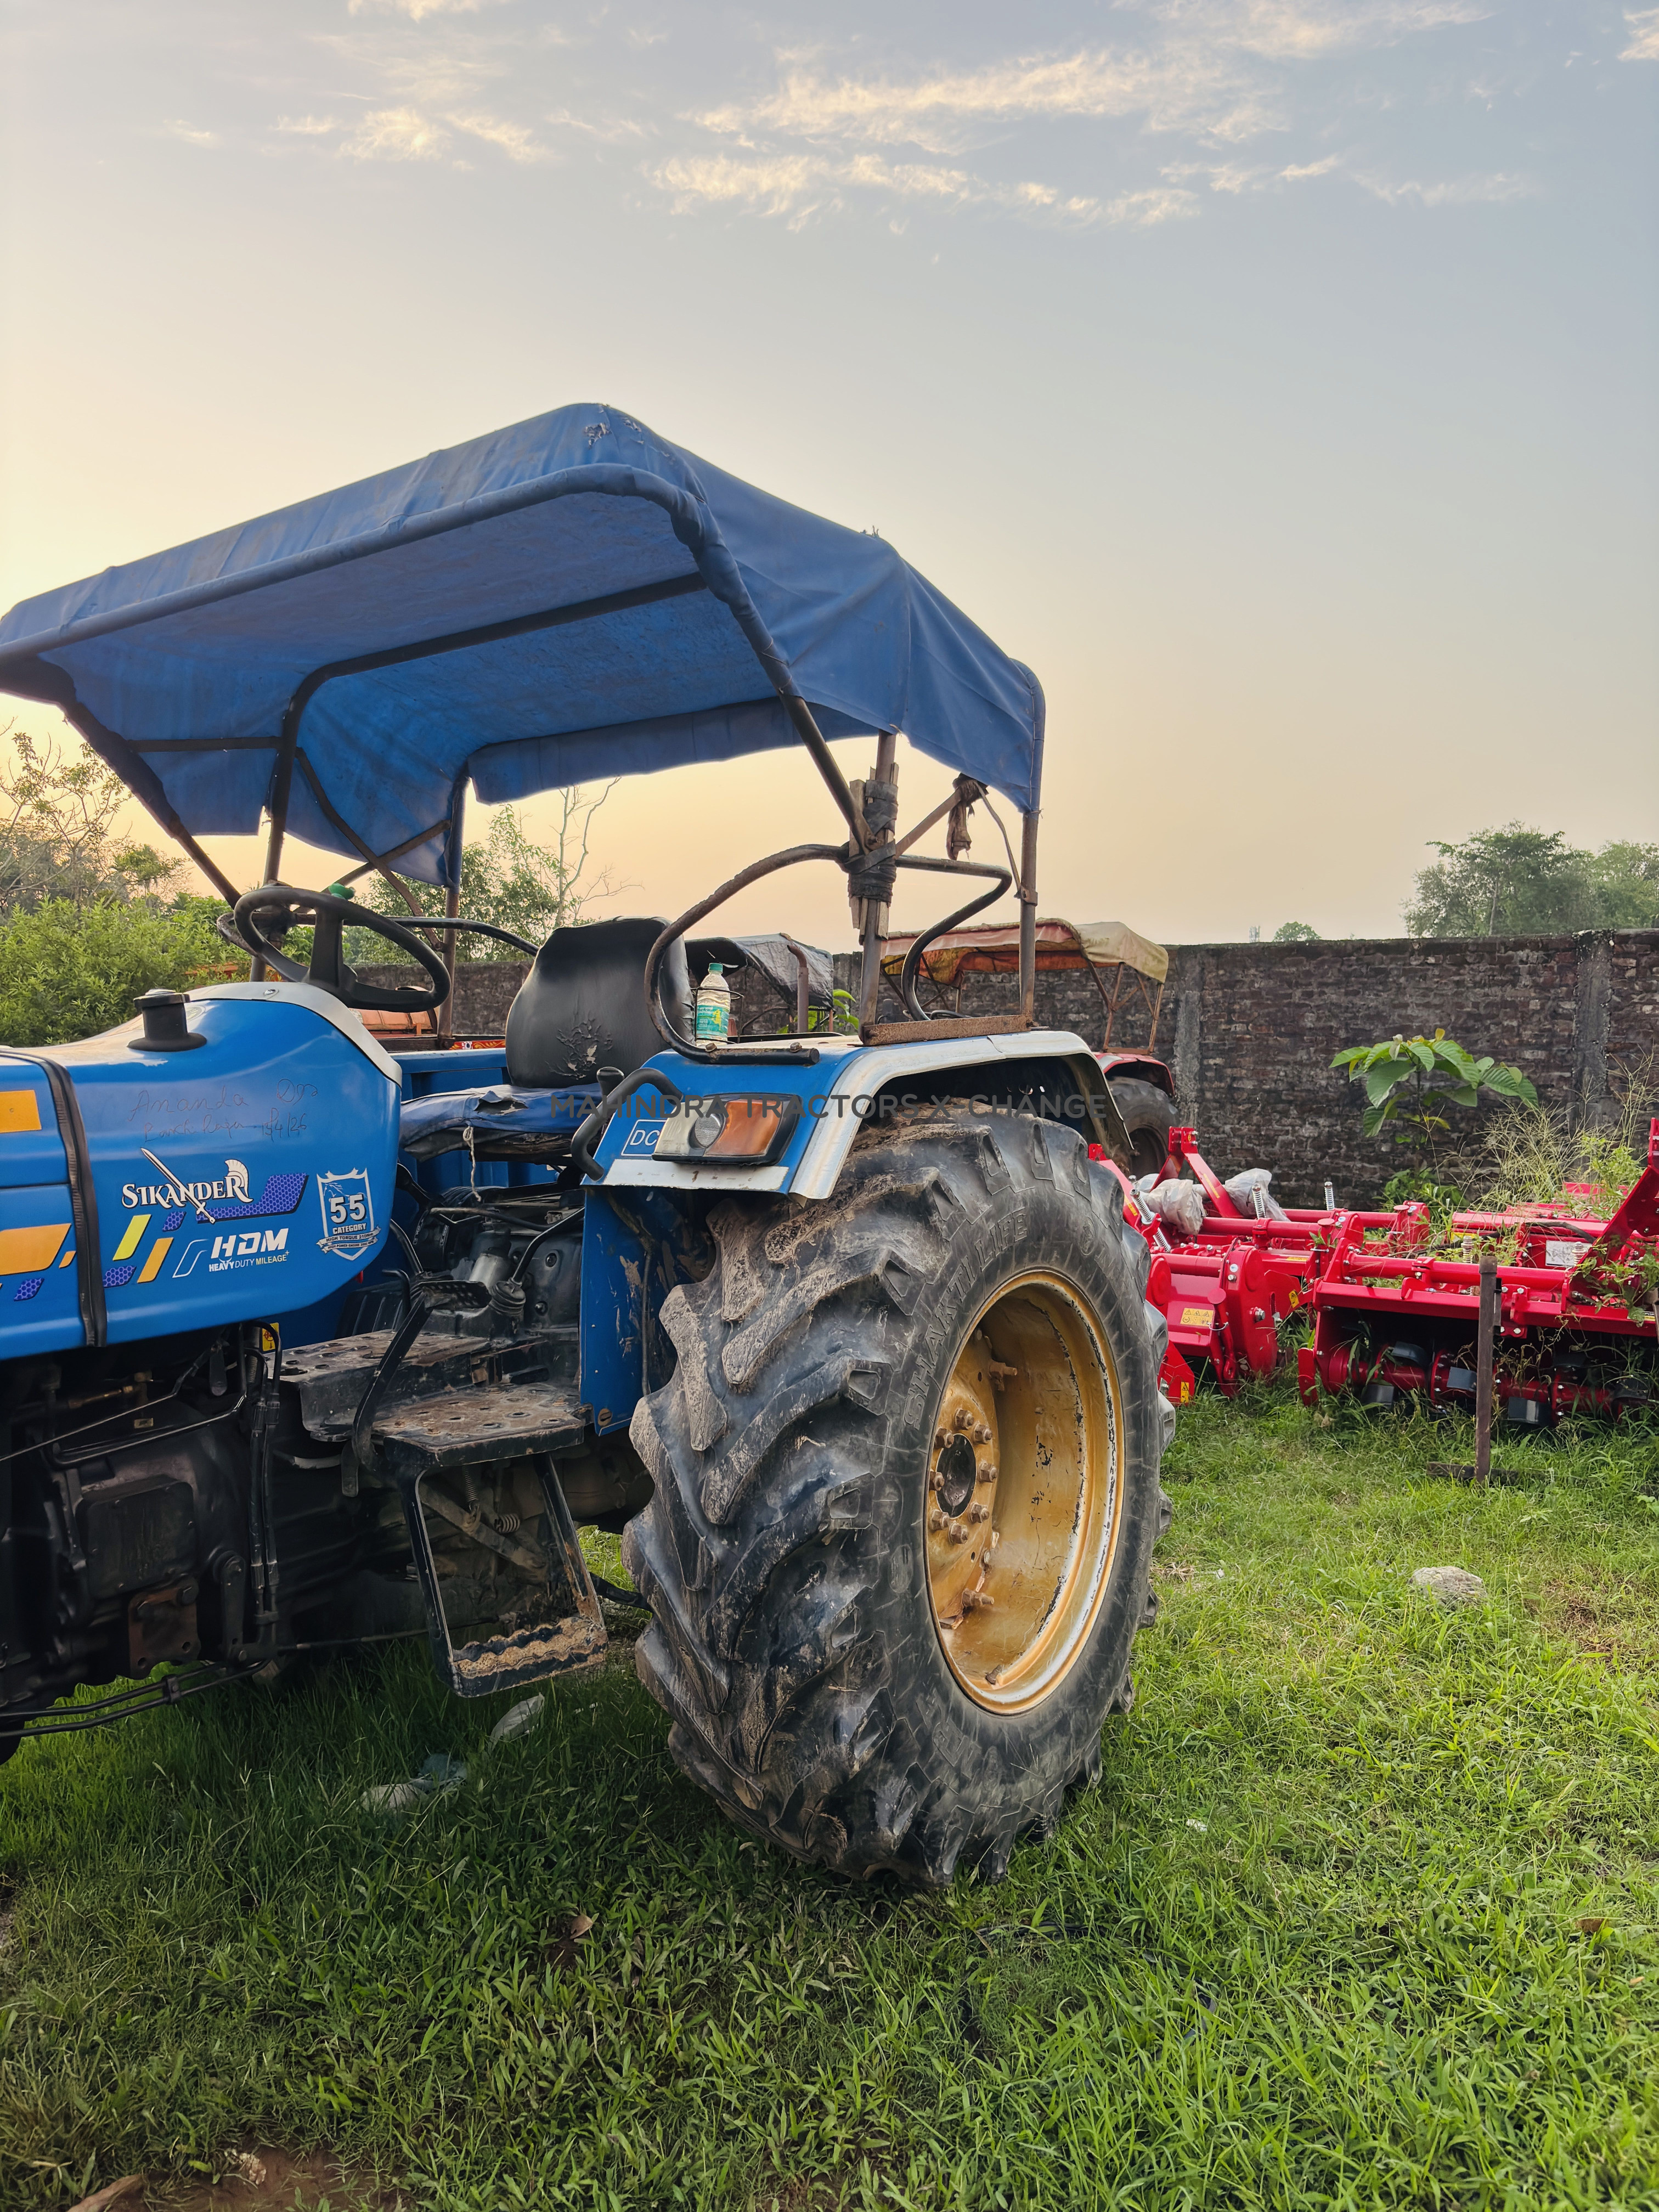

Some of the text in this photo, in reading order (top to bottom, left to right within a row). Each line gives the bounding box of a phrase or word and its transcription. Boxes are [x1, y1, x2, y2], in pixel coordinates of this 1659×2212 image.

[122, 1176, 253, 1208] SIKANDER
[330, 1194, 366, 1224] 55
[211, 1228, 289, 1259] HDM
[332, 1223, 366, 1234] CATEGORY
[974, 1207, 1029, 1273] LIFE
[209, 1261, 234, 1272] HEAVY
[235, 1258, 255, 1268] DUTY
